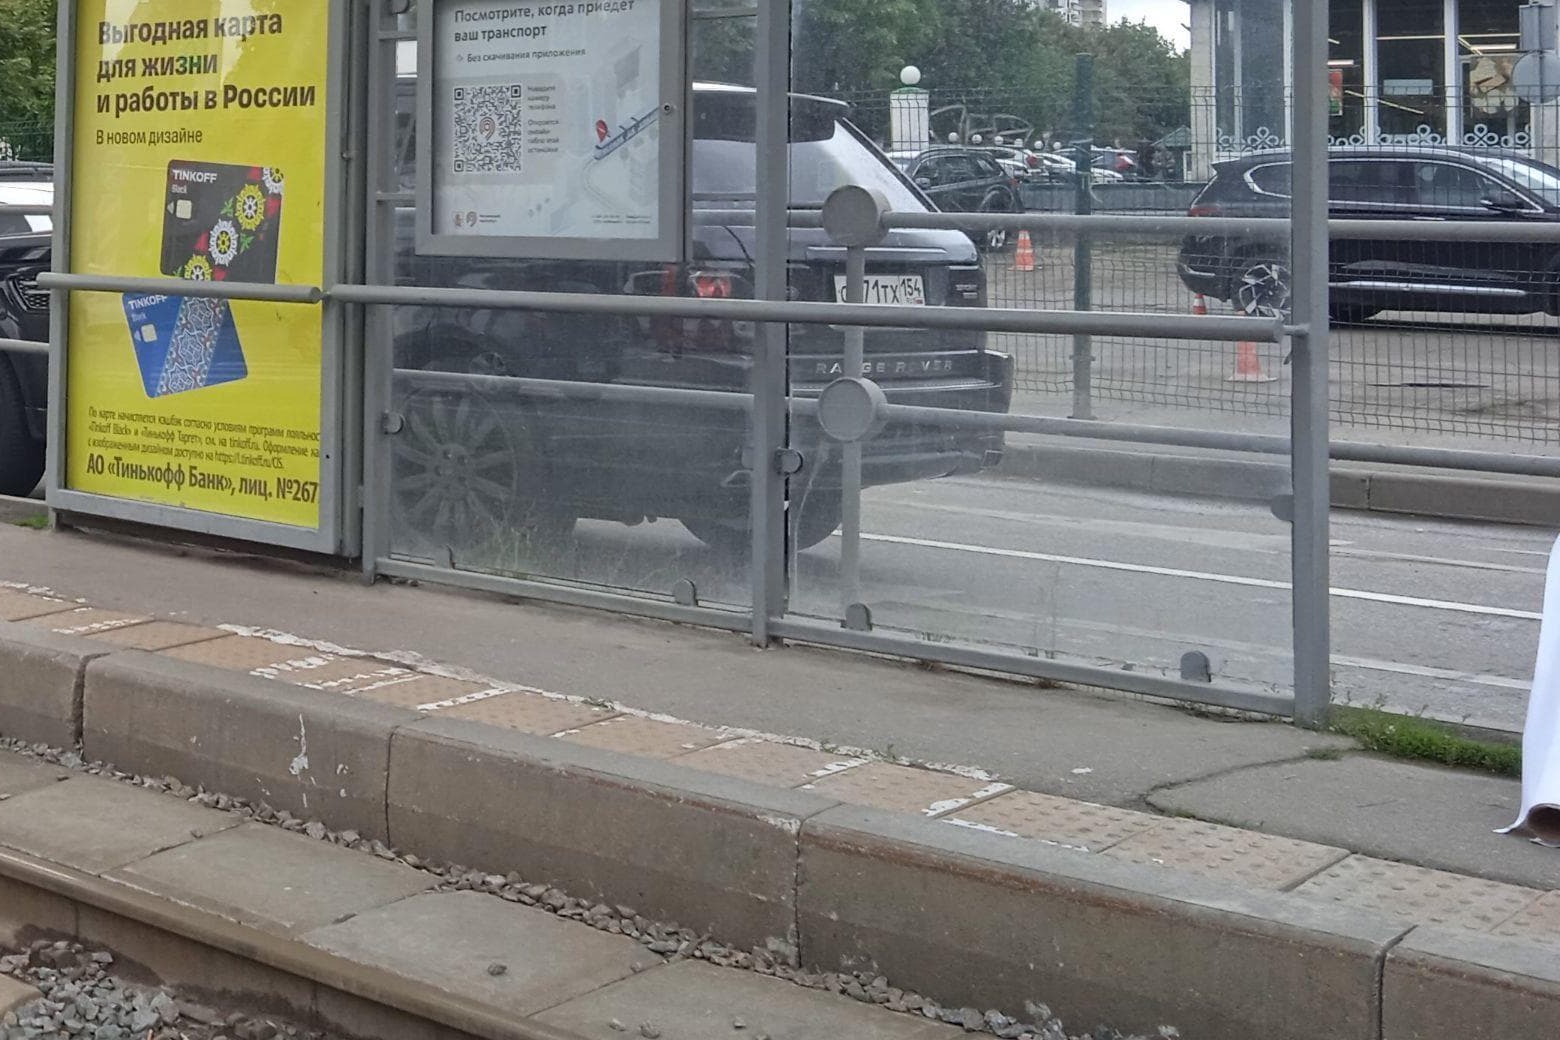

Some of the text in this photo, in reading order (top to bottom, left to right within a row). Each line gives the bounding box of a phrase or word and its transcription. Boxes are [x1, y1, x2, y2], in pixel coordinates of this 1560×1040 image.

[454, 0, 635, 25] Посмотрите, когда приедет
[98, 12, 283, 46] Выгодная карта
[454, 25, 547, 42] ваш транспорт
[96, 53, 218, 84] для жизни
[97, 85, 316, 118] и работы в России
[96, 128, 203, 146] В новом дизайне
[172, 169, 217, 184] TINKOFF
[901, 278, 922, 298] 154
[127, 294, 168, 310] TINKOFF
[816, 360, 953, 374] RAGE RVER
[86, 452, 105, 476] АО
[107, 455, 185, 492] «Тинькофф
[189, 465, 236, 497] Банк»,
[238, 477, 273, 502] лиц.
